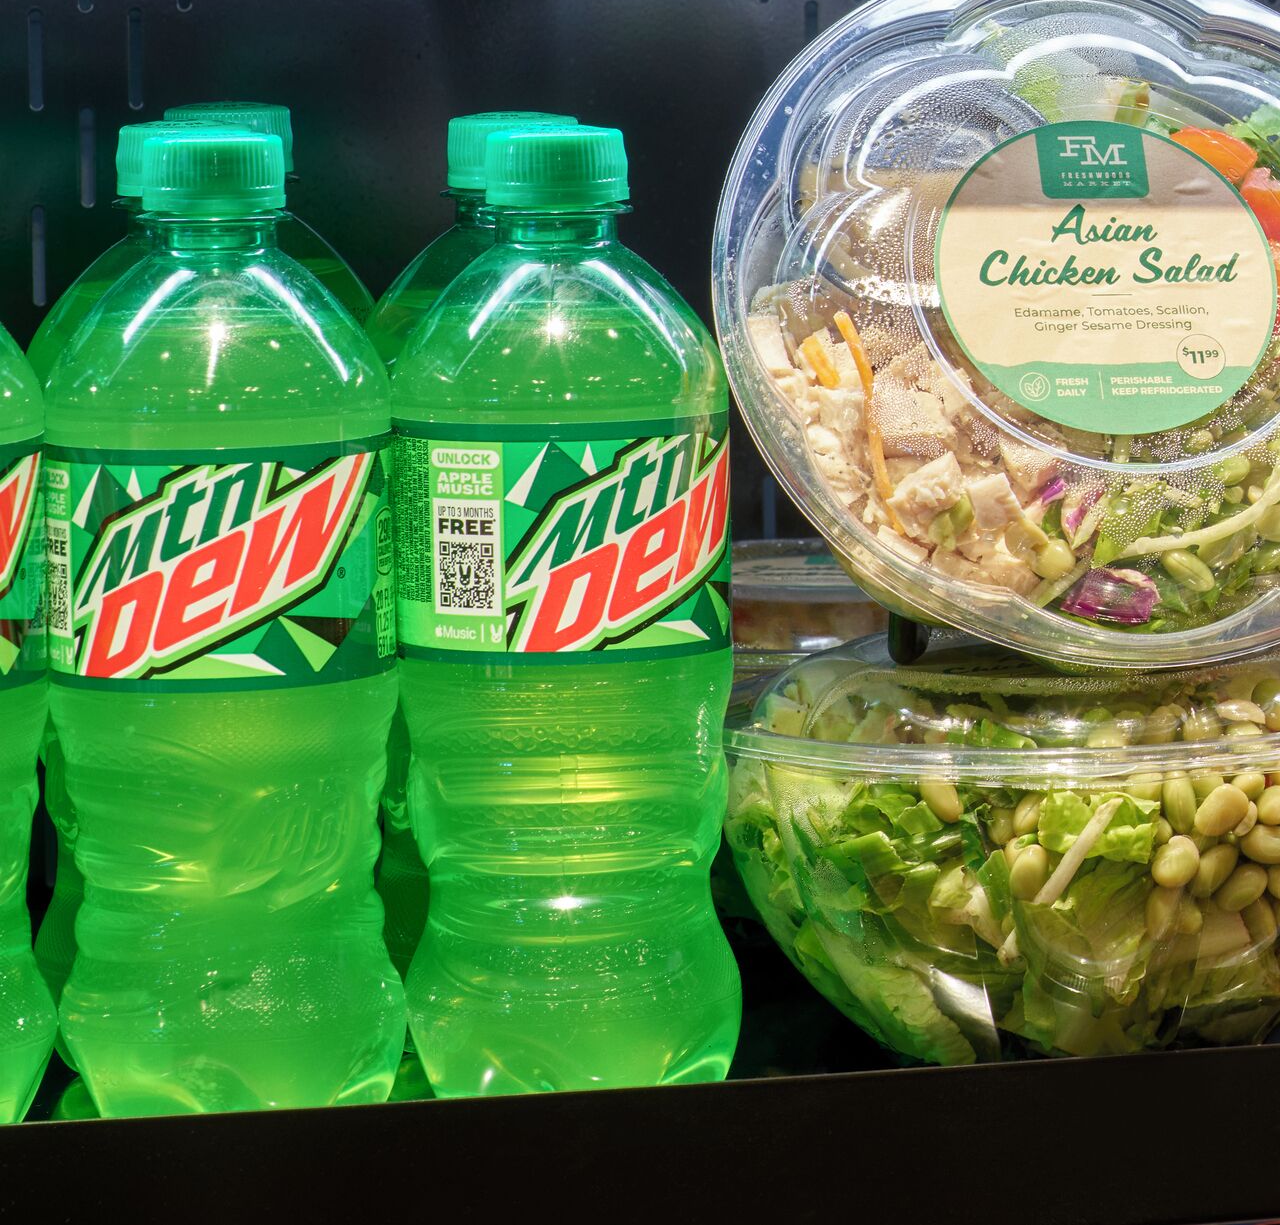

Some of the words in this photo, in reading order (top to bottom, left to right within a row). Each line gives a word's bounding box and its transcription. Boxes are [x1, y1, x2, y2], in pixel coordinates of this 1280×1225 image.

[1057, 135, 1127, 166] FM
[1051, 203, 1158, 246] Asian
[978, 249, 1122, 287] Chicken
[1132, 246, 1240, 285] Salad
[1014, 306, 1085, 319] Edamame,
[1087, 306, 1154, 318] Tomatoes,
[1156, 305, 1210, 318] Scallion,
[1034, 320, 1079, 334] Ginger
[1081, 320, 1134, 331] Sesame
[1136, 319, 1193, 333] Dressing
[1055, 378, 1089, 386] FRESH
[1110, 376, 1173, 385] PERISHABLE
[1056, 388, 1087, 397] DAILY
[1111, 387, 1138, 396] KEEP
[437, 452, 491, 465] UNLOCK
[437, 471, 493, 485] APPLE
[437, 483, 494, 495] MUSIC
[438, 506, 447, 517] UP
[448, 506, 456, 517] TO
[457, 507, 462, 517] 3
[463, 507, 494, 518] MONTHS
[512, 434, 697, 588] Mtn
[78, 463, 263, 611] Mtn
[442, 626, 477, 640] Music
